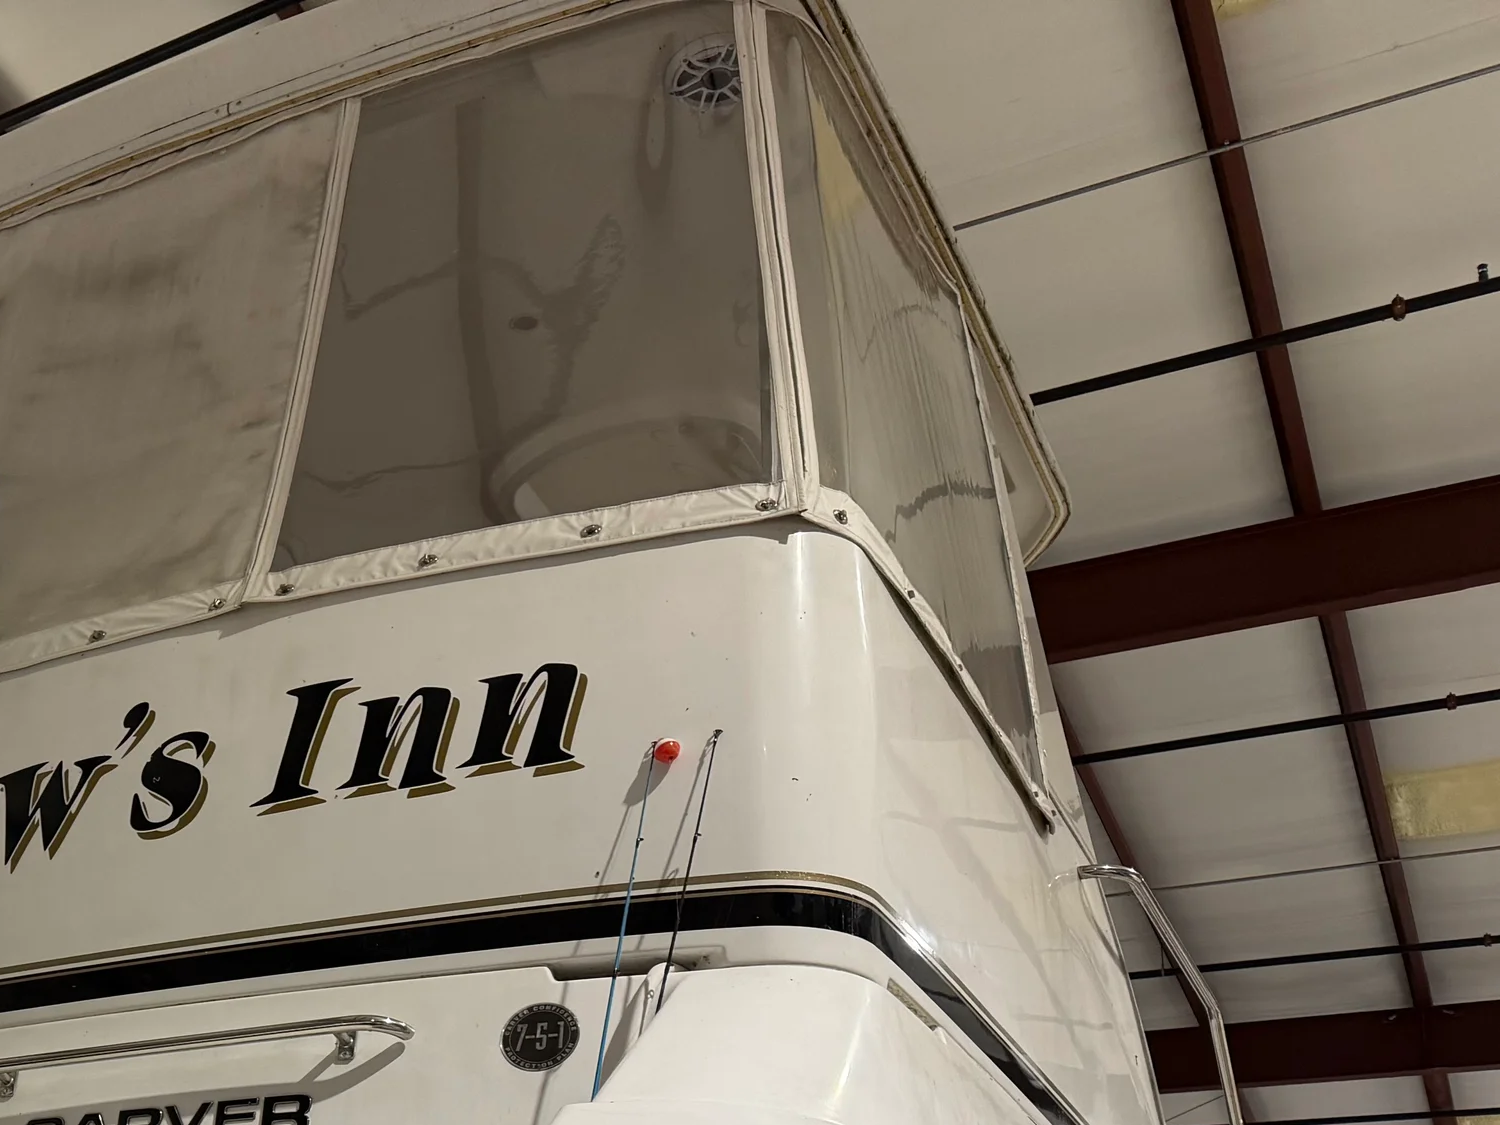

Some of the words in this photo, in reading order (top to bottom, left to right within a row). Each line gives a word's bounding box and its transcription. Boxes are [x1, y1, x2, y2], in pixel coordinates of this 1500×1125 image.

[250, 663, 588, 817] Inn
[504, 1008, 530, 1036] CARVER
[533, 1005, 577, 1031] CONFIDENCE
[515, 1021, 565, 1052] 7-5-1
[505, 1047, 554, 1069] PROTECTION
[556, 1042, 575, 1061] PLAN
